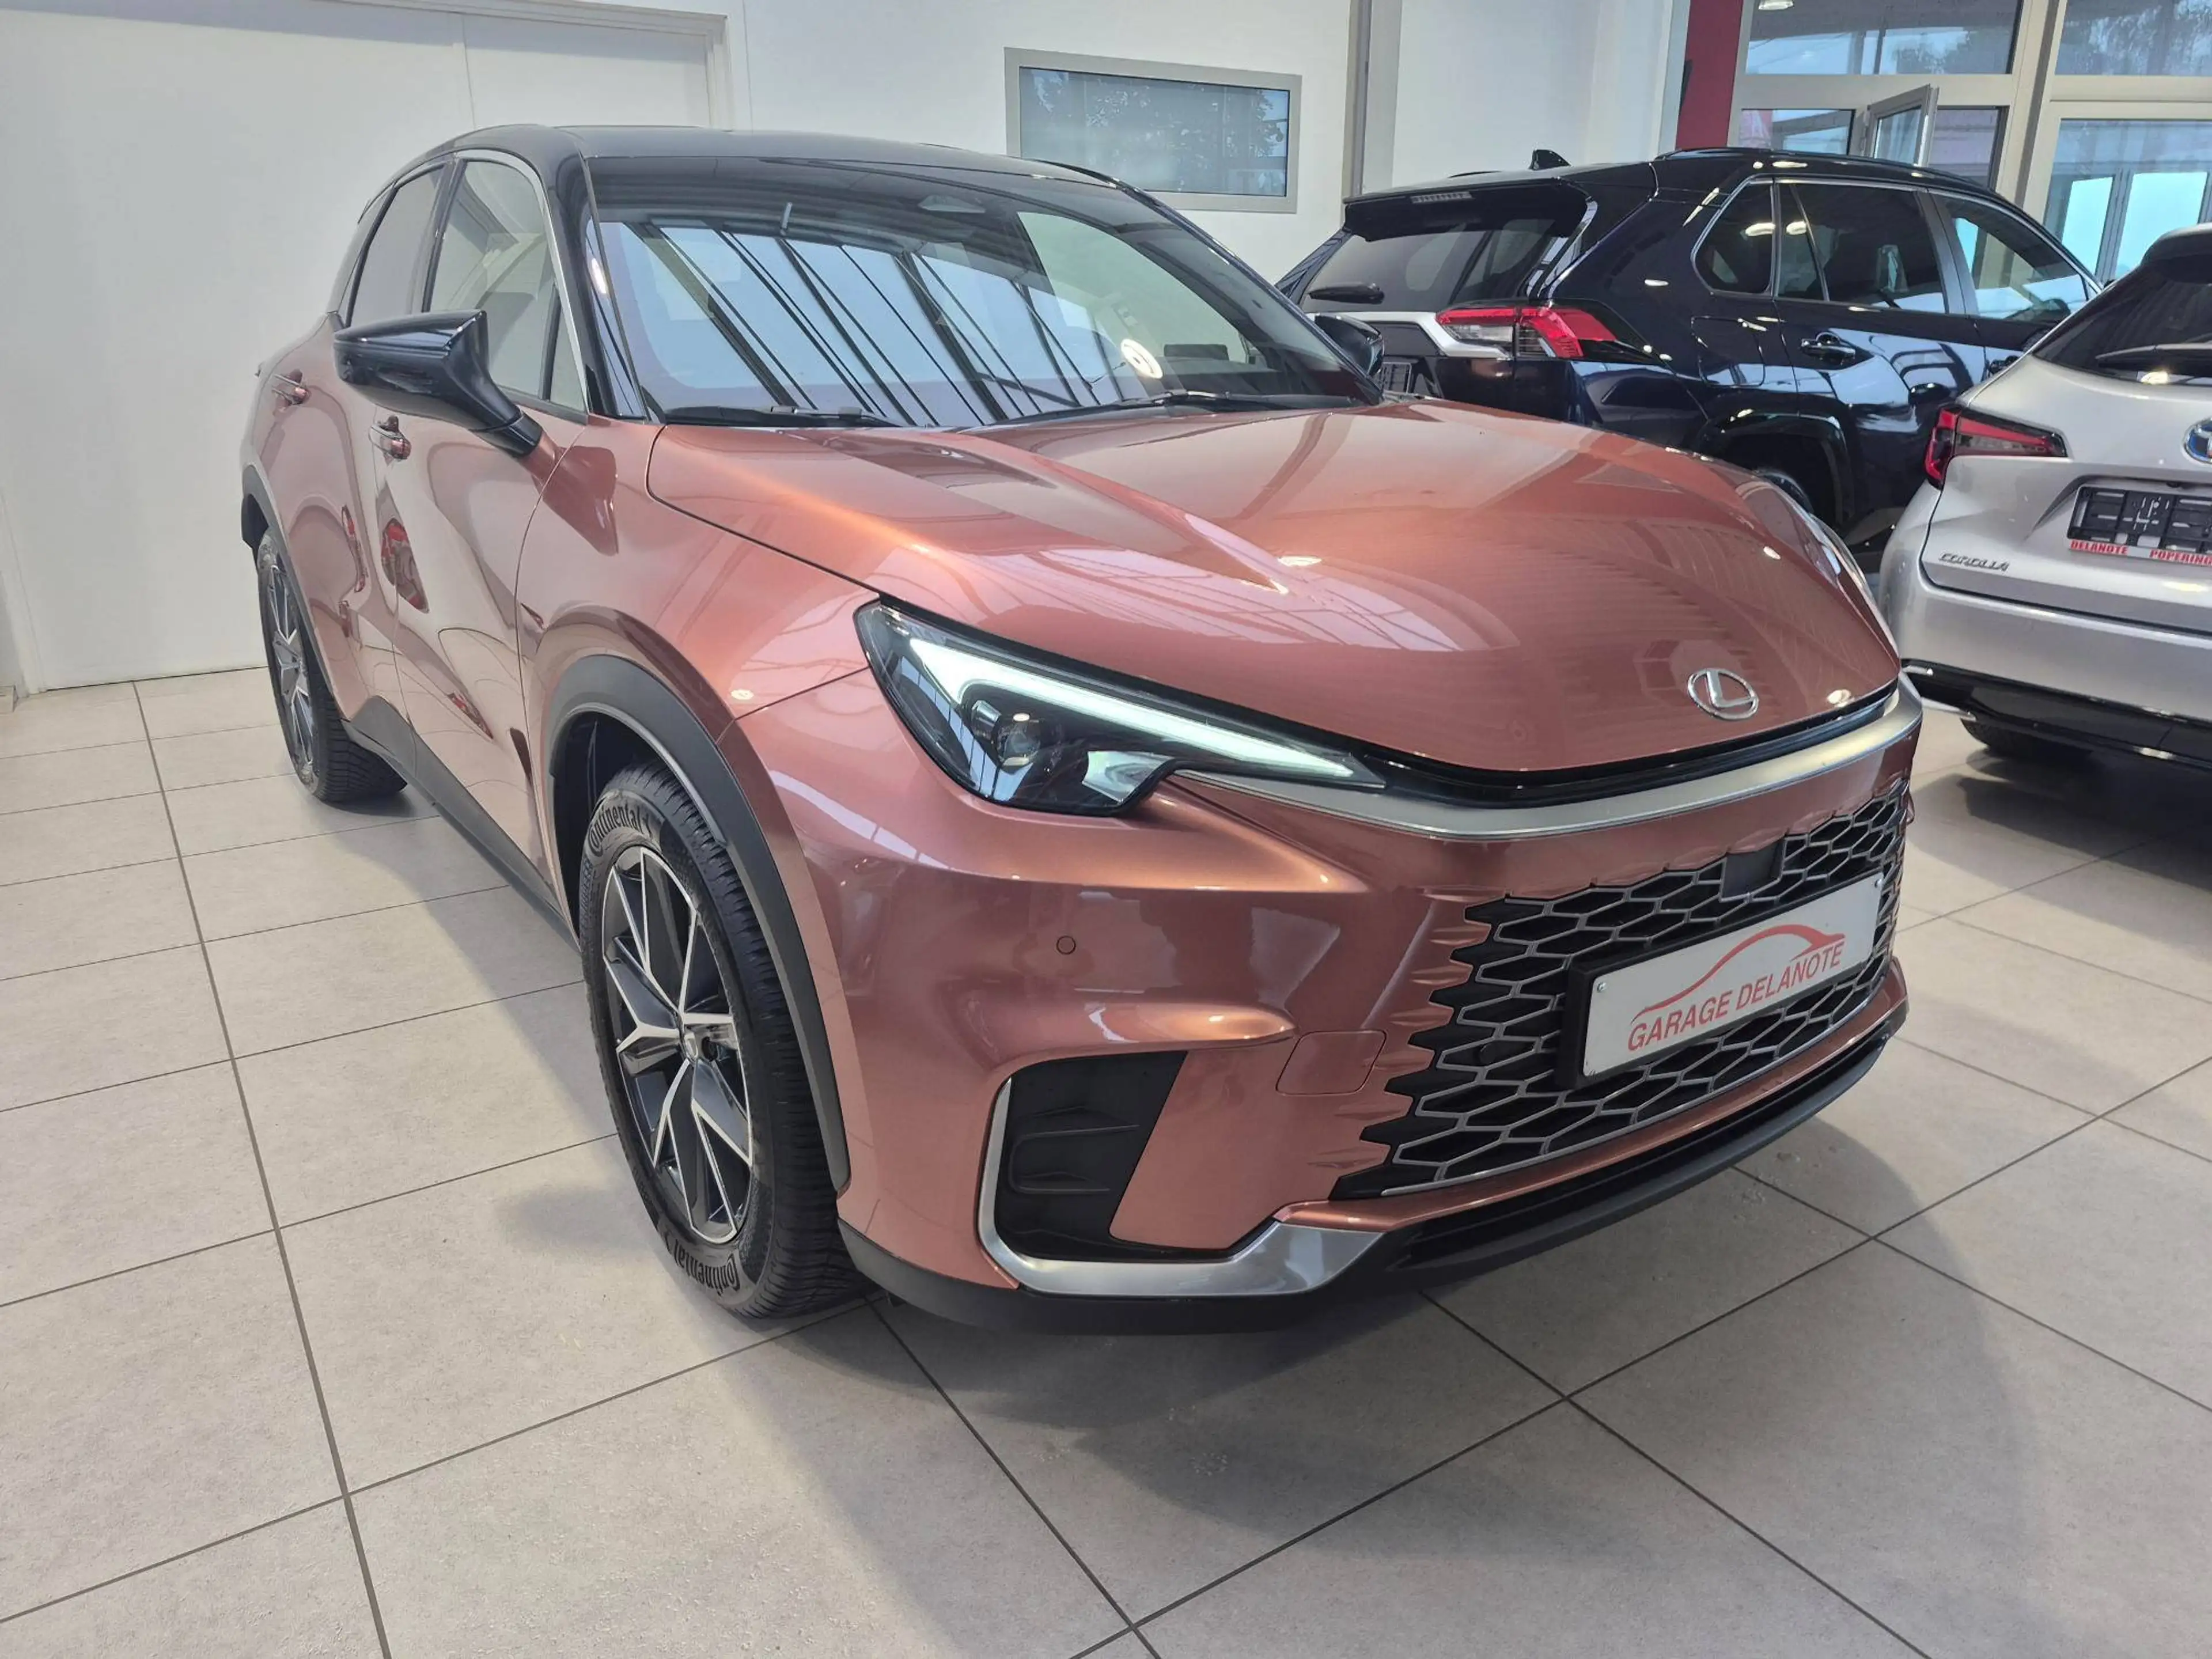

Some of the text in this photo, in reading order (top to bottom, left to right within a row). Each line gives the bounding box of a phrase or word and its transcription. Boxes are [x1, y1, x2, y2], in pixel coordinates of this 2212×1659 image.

[1938, 552, 2010, 572] COROLLA
[2071, 540, 2128, 555] DELANOTE
[588, 800, 645, 857] Continental
[1628, 943, 1844, 1051] GARAGE DELANOTE
[673, 1238, 741, 1297] Continental
